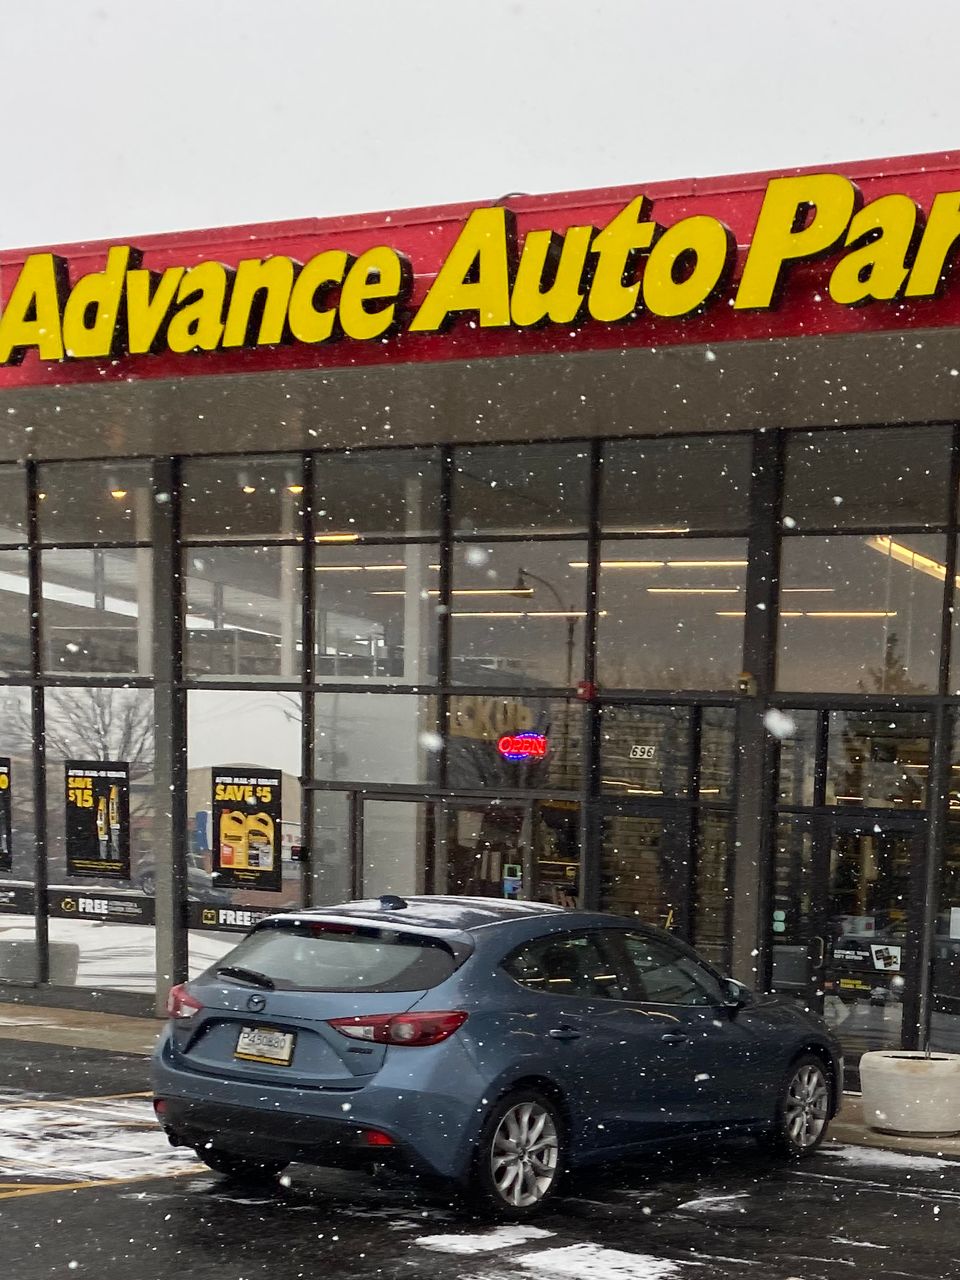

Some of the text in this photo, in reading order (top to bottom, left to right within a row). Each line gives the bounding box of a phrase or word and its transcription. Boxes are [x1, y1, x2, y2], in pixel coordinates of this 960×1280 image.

[0, 245, 406, 364] Advance
[409, 195, 733, 331] Auto
[498, 736, 545, 754] OPEN
[632, 746, 654, 758] 696
[68, 777, 93, 789] SAVE
[68, 789, 94, 808] $15
[215, 785, 272, 803] SAVE $5
[78, 898, 108, 915] FREE
[218, 909, 252, 927] FREE
